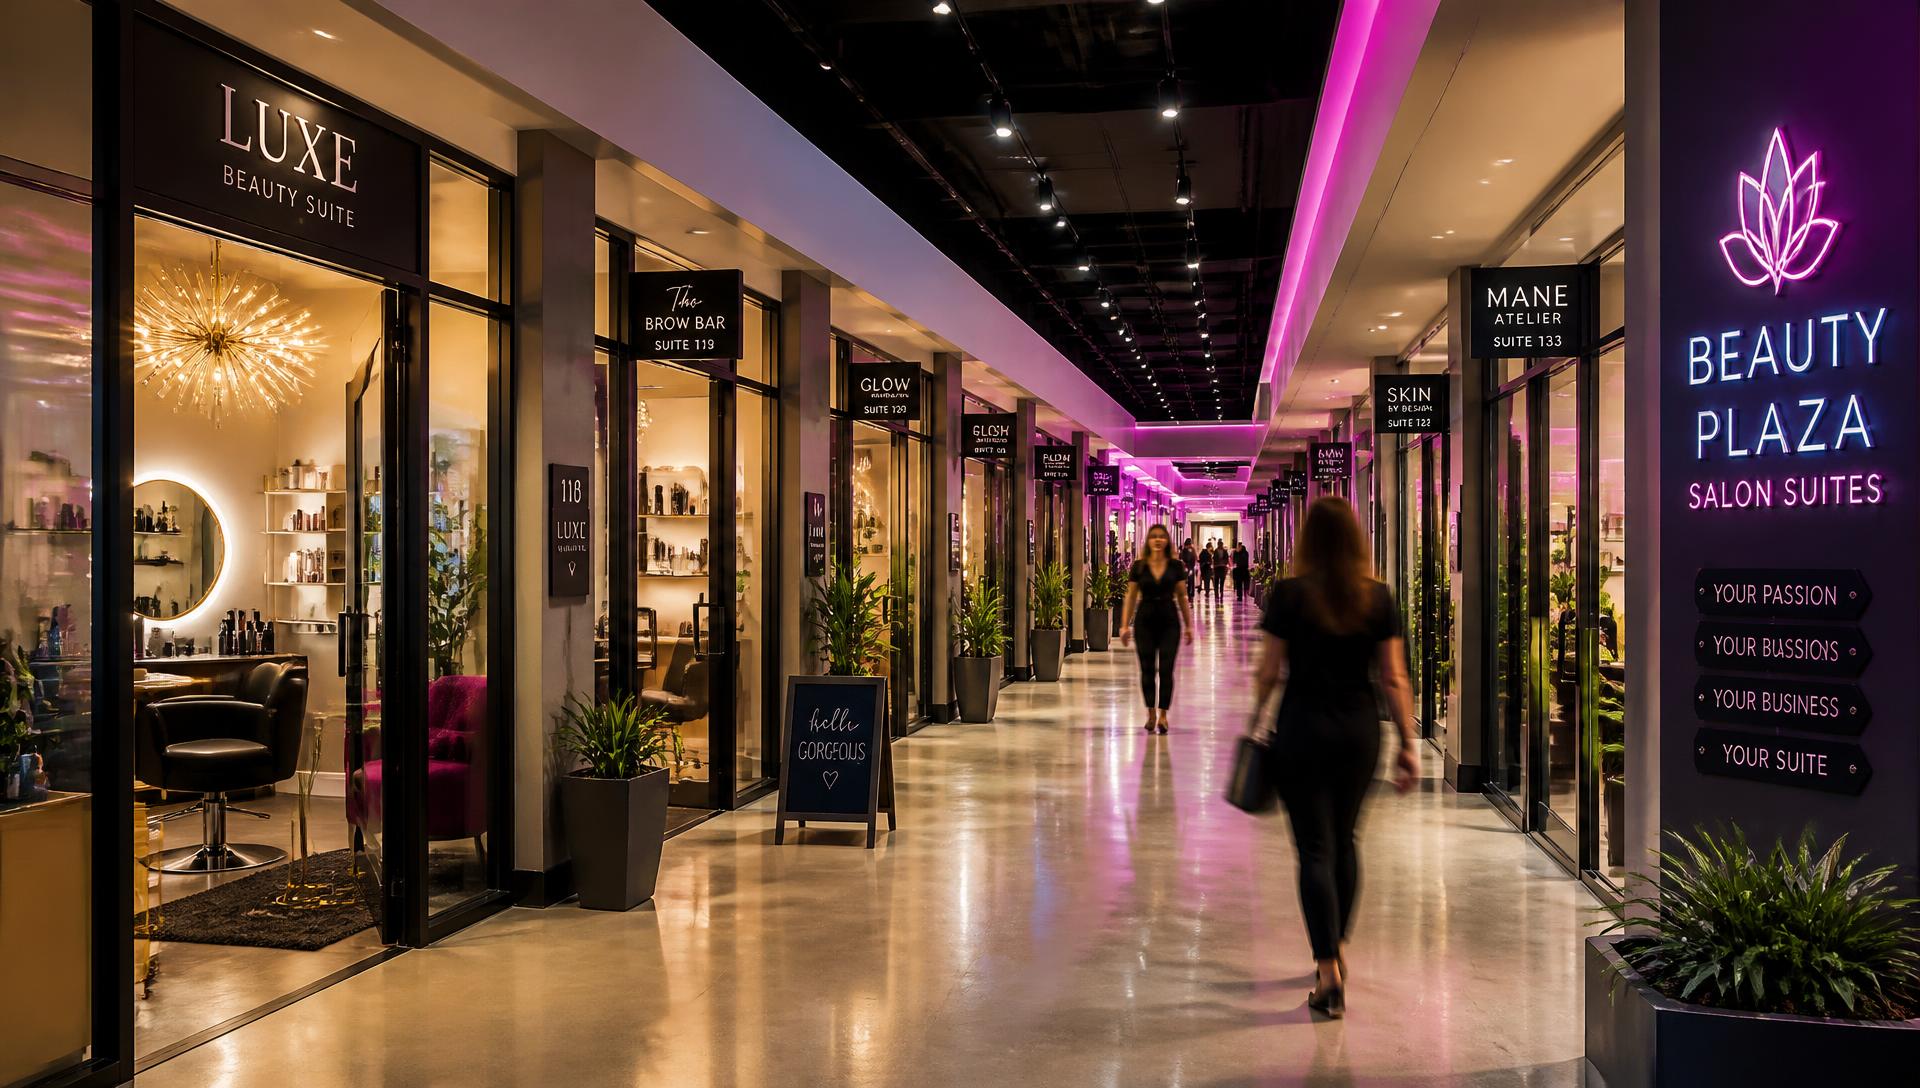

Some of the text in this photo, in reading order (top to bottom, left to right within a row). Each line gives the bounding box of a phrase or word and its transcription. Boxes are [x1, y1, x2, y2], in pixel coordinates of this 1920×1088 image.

[220, 83, 357, 193] LUXE
[223, 164, 355, 228] BEAUTY SUITE
[1487, 284, 1568, 308] MANE
[645, 315, 726, 331] BROW BAR
[1494, 312, 1561, 325] ATELIER
[655, 339, 715, 351] SUITE 119
[1493, 335, 1562, 348] SUITE 133
[1689, 307, 1888, 386] BEAUTY
[860, 377, 911, 392] GLOW
[1387, 387, 1431, 403] SKIN
[864, 405, 889, 414] SUITE
[1387, 419, 1413, 428] SUITE
[1697, 394, 1875, 459] PLAZA
[561, 479, 582, 504] 118
[1688, 473, 1883, 509] SALON SUITES
[1713, 583, 1837, 606] YOUR PASSION
[1713, 635, 1757, 657] YOUR
[1713, 688, 1839, 718] YOUR BUSINESS
[1723, 743, 1828, 776] YOUR SUITE
